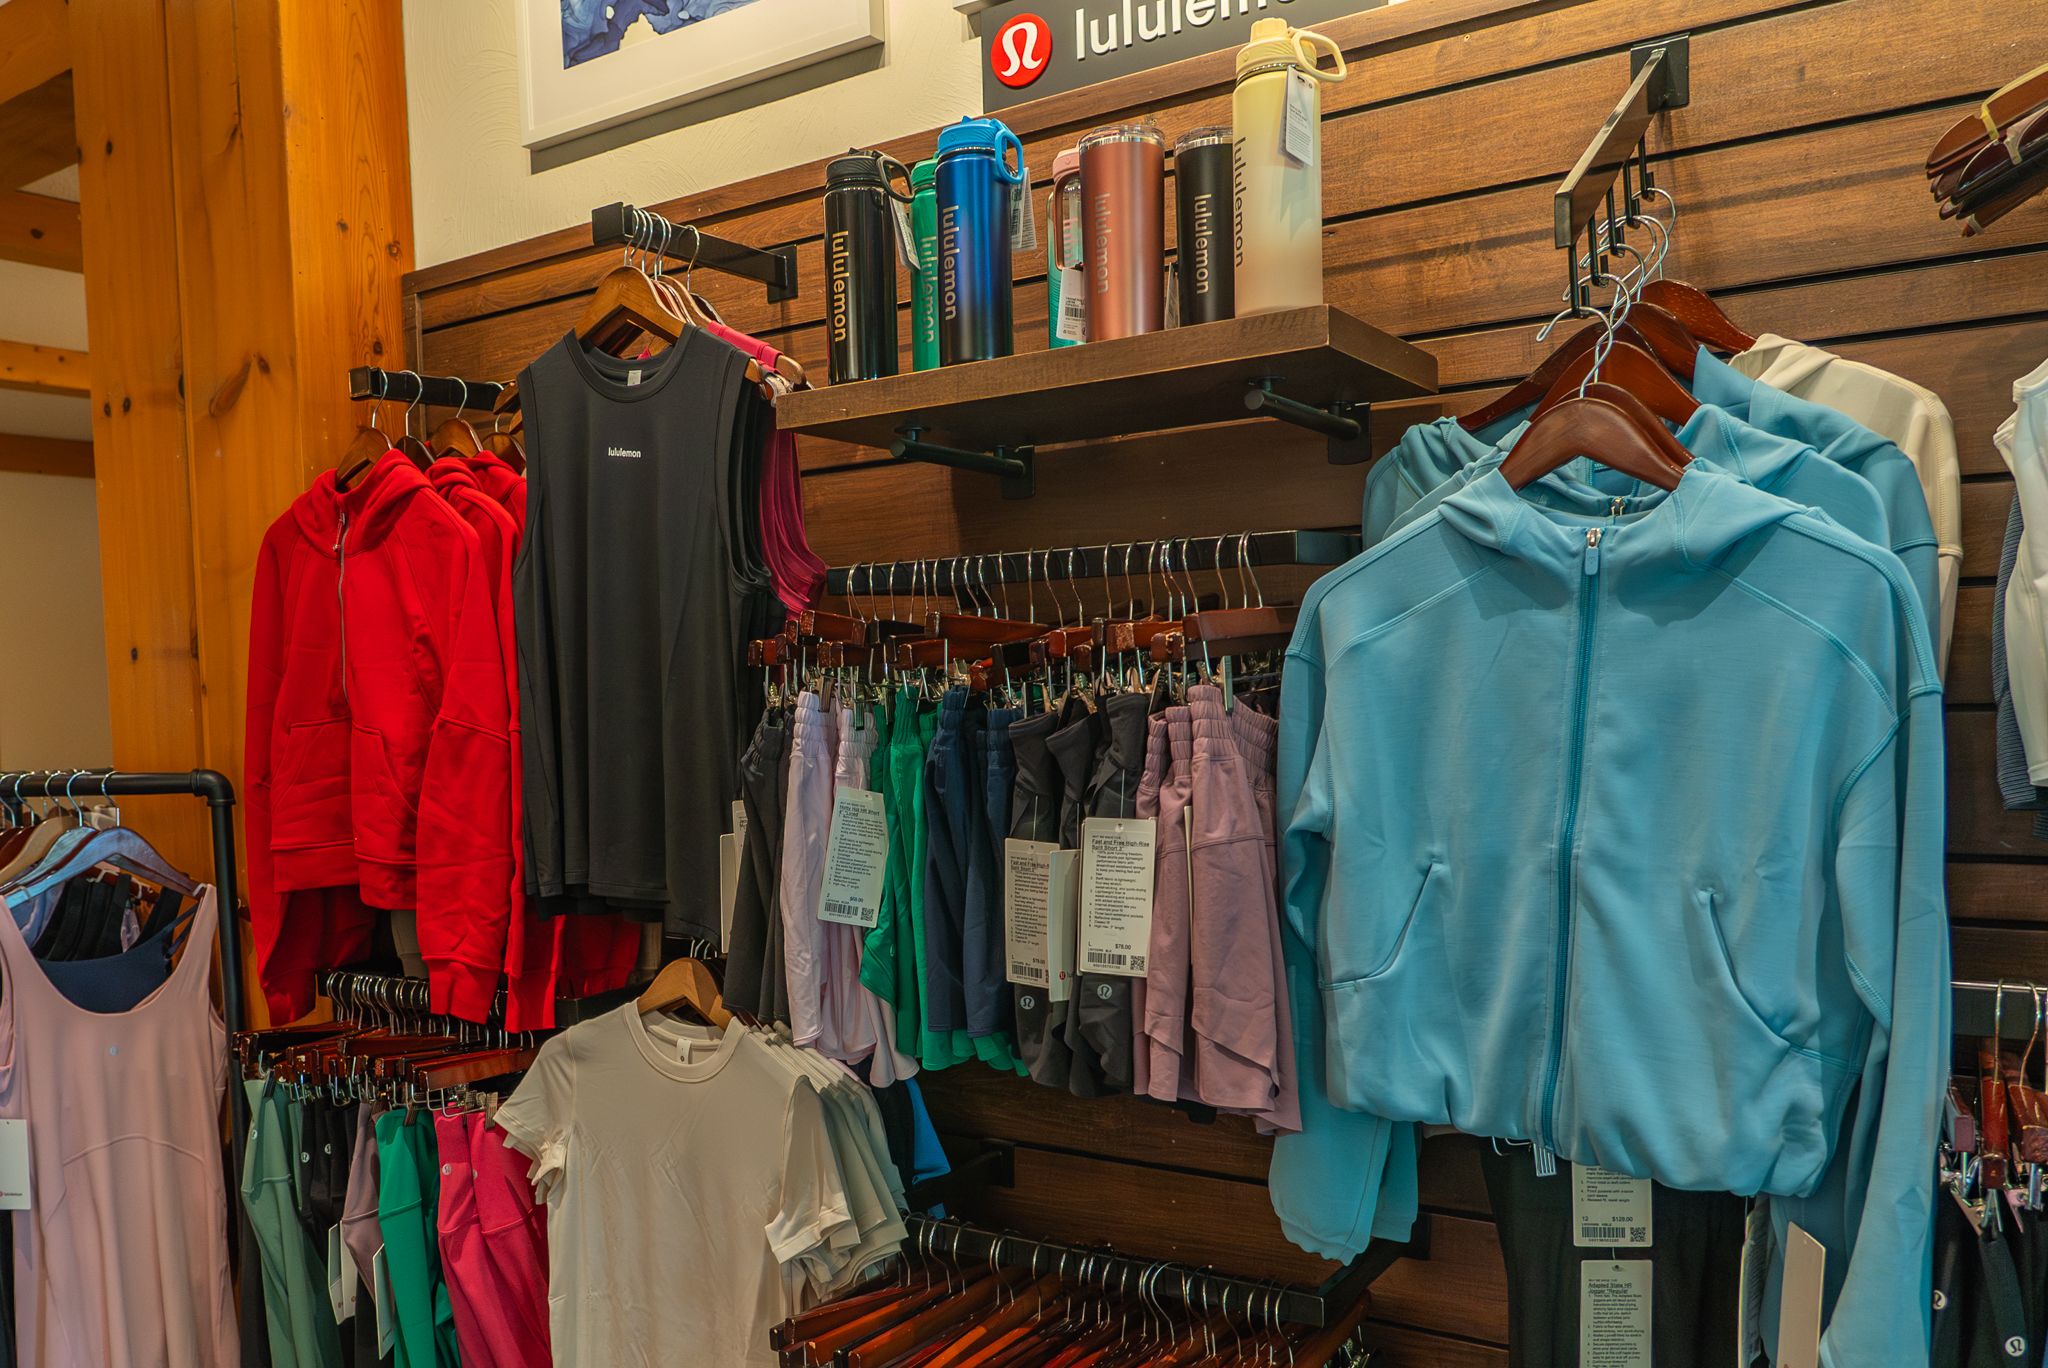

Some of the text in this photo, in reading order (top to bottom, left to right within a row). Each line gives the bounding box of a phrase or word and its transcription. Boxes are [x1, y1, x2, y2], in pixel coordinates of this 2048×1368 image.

[1076, 0, 1296, 60] lulule
[1094, 192, 1112, 294] lululemon
[1194, 193, 1213, 295] lululemon
[1234, 136, 1247, 268] lululemon
[832, 230, 850, 342] lululemon
[920, 236, 938, 343] lululemon
[942, 205, 960, 321] lululemon
[608, 447, 642, 458] lululemon
